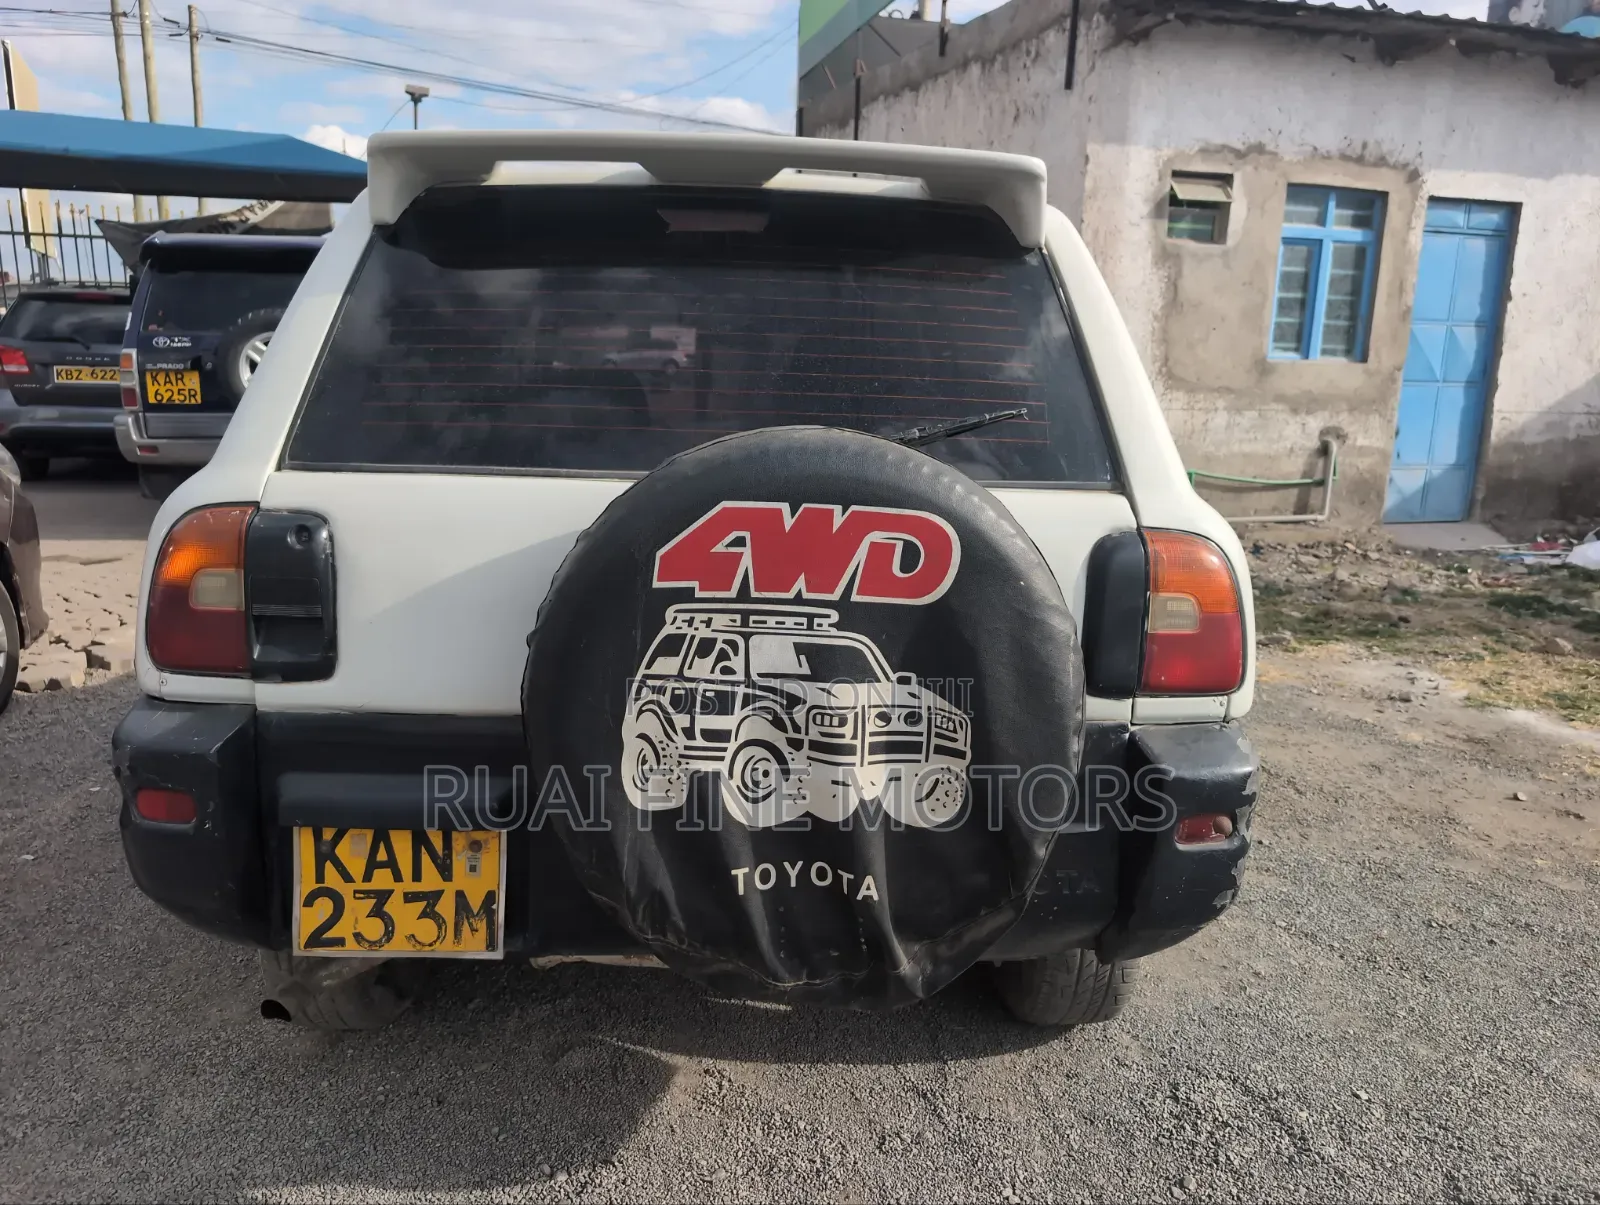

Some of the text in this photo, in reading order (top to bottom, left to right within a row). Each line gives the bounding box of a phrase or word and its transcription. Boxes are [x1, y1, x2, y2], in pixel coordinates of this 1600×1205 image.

[56, 368, 83, 381] KBZ
[150, 371, 186, 387] KAR
[154, 388, 199, 404] 625R
[652, 500, 962, 606] 4WD
[312, 826, 453, 884] KAN
[731, 860, 879, 902] TOYOTA
[302, 886, 497, 952] 233M
